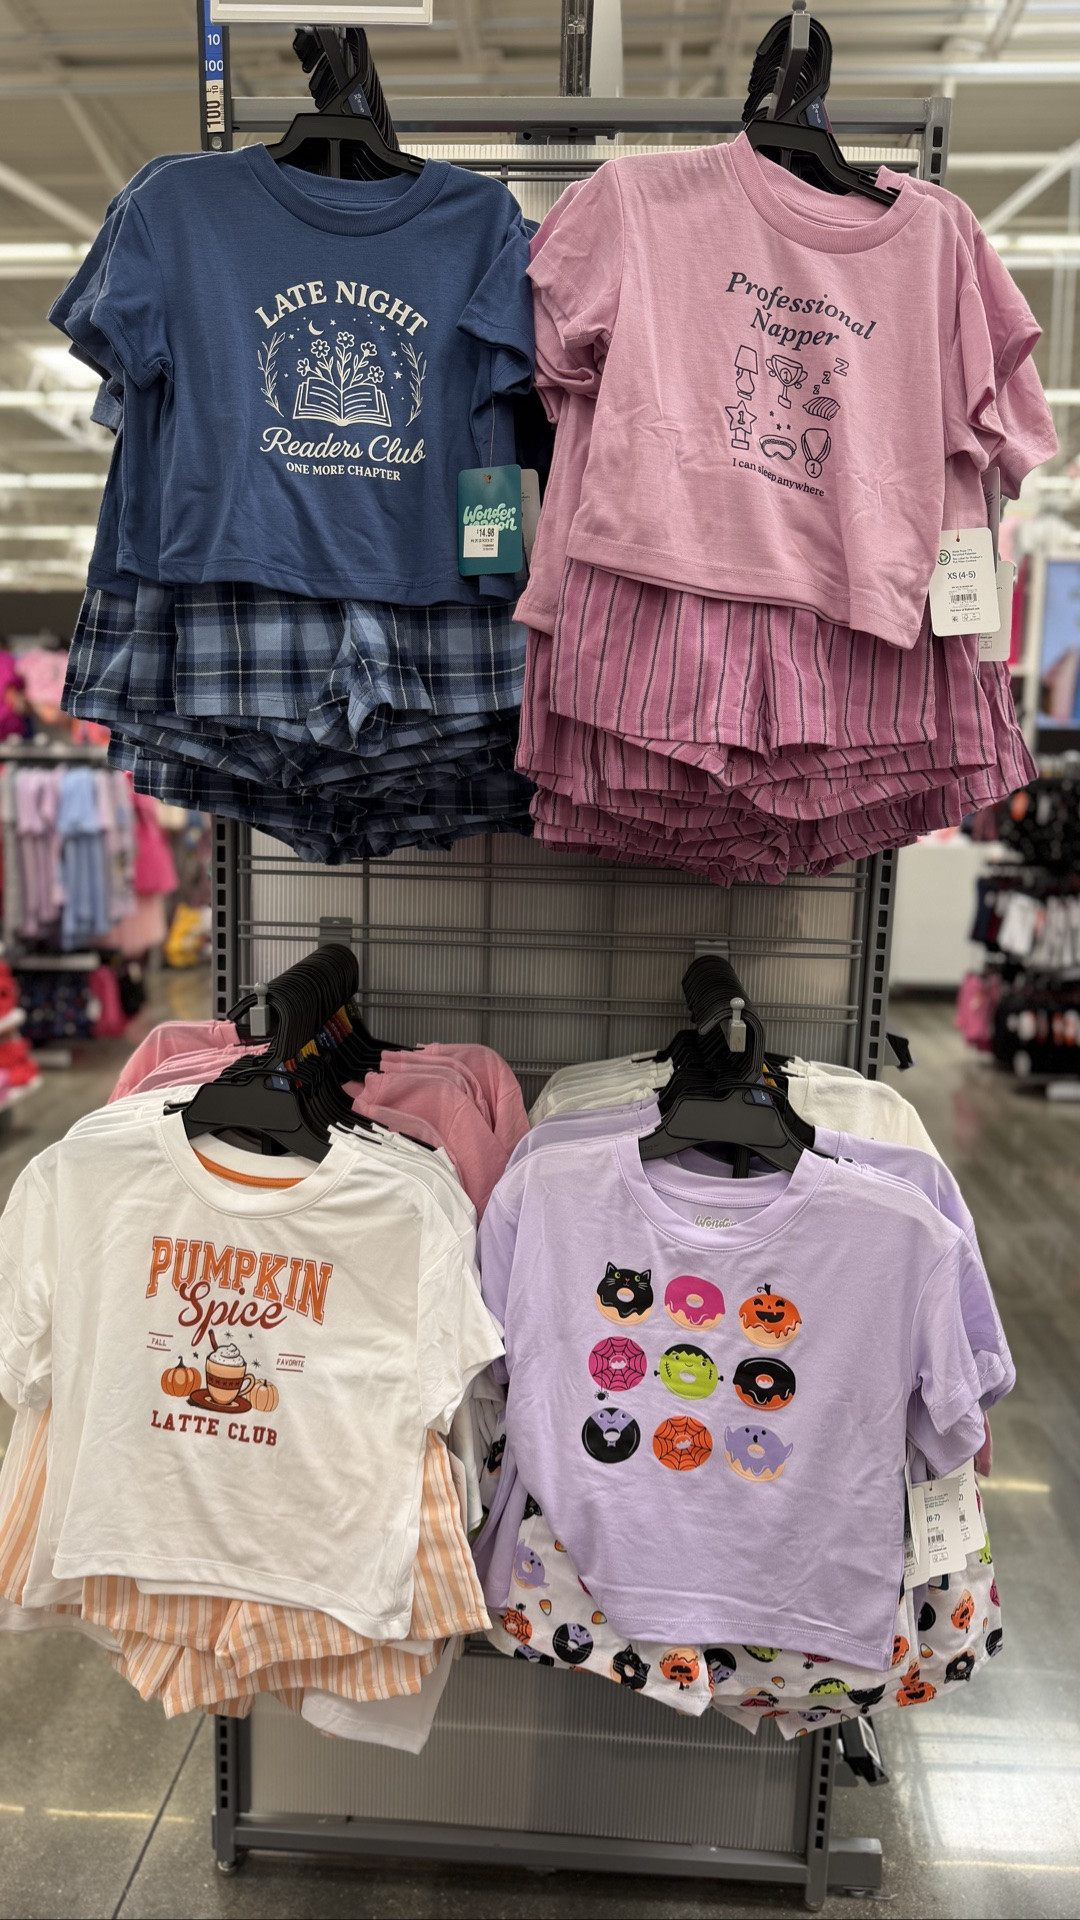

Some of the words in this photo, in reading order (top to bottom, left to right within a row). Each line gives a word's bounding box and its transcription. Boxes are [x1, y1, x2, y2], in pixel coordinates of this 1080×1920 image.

[207, 33, 220, 46] 10
[205, 60, 224, 72] 100
[206, 100, 221, 128] 100
[254, 280, 328, 329] LATE
[335, 280, 428, 337] NIGHT
[726, 271, 877, 340] Professional
[750, 307, 840, 352] Napper
[259, 426, 364, 458] Readers
[367, 434, 427, 464] Club
[286, 461, 310, 475] ONE
[312, 464, 345, 476] MORE
[347, 465, 401, 482] CHAPTER
[732, 458, 737, 467] I
[738, 460, 756, 472] can
[757, 465, 777, 483] sleep
[777, 475, 825, 497] anywhere
[463, 503, 517, 524] Wonder
[947, 572, 958, 580] XS
[958, 570, 976, 580] (4-5)
[145, 1236, 333, 1326] PUMPKIN
[178, 1281, 288, 1347] Spice
[151, 1337, 167, 1347] FALL
[276, 1357, 305, 1368] FAVORITE
[150, 1409, 220, 1436] LATTE
[227, 1422, 278, 1447] CLUB
